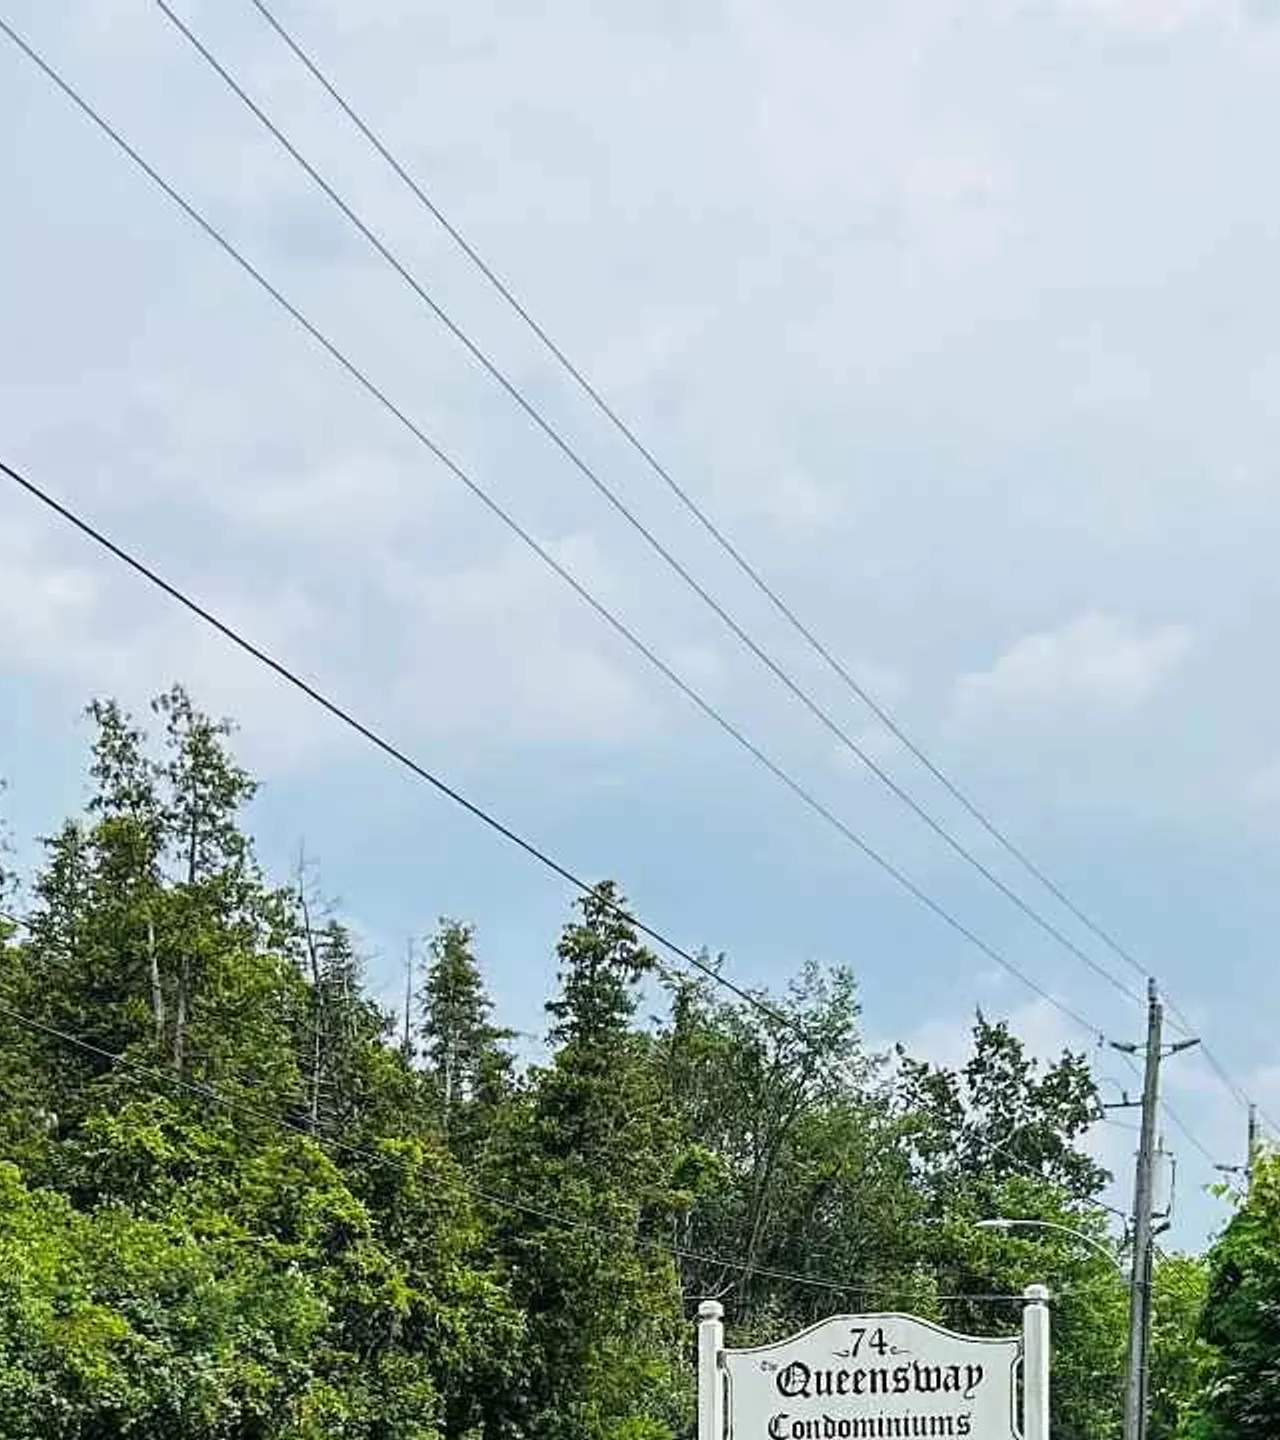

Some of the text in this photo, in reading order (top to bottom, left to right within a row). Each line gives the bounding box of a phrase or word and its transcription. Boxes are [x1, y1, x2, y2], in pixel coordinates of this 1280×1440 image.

[851, 1328, 888, 1356] 74
[776, 1361, 984, 1399] Queensway
[768, 1410, 972, 1440] Condominiums
